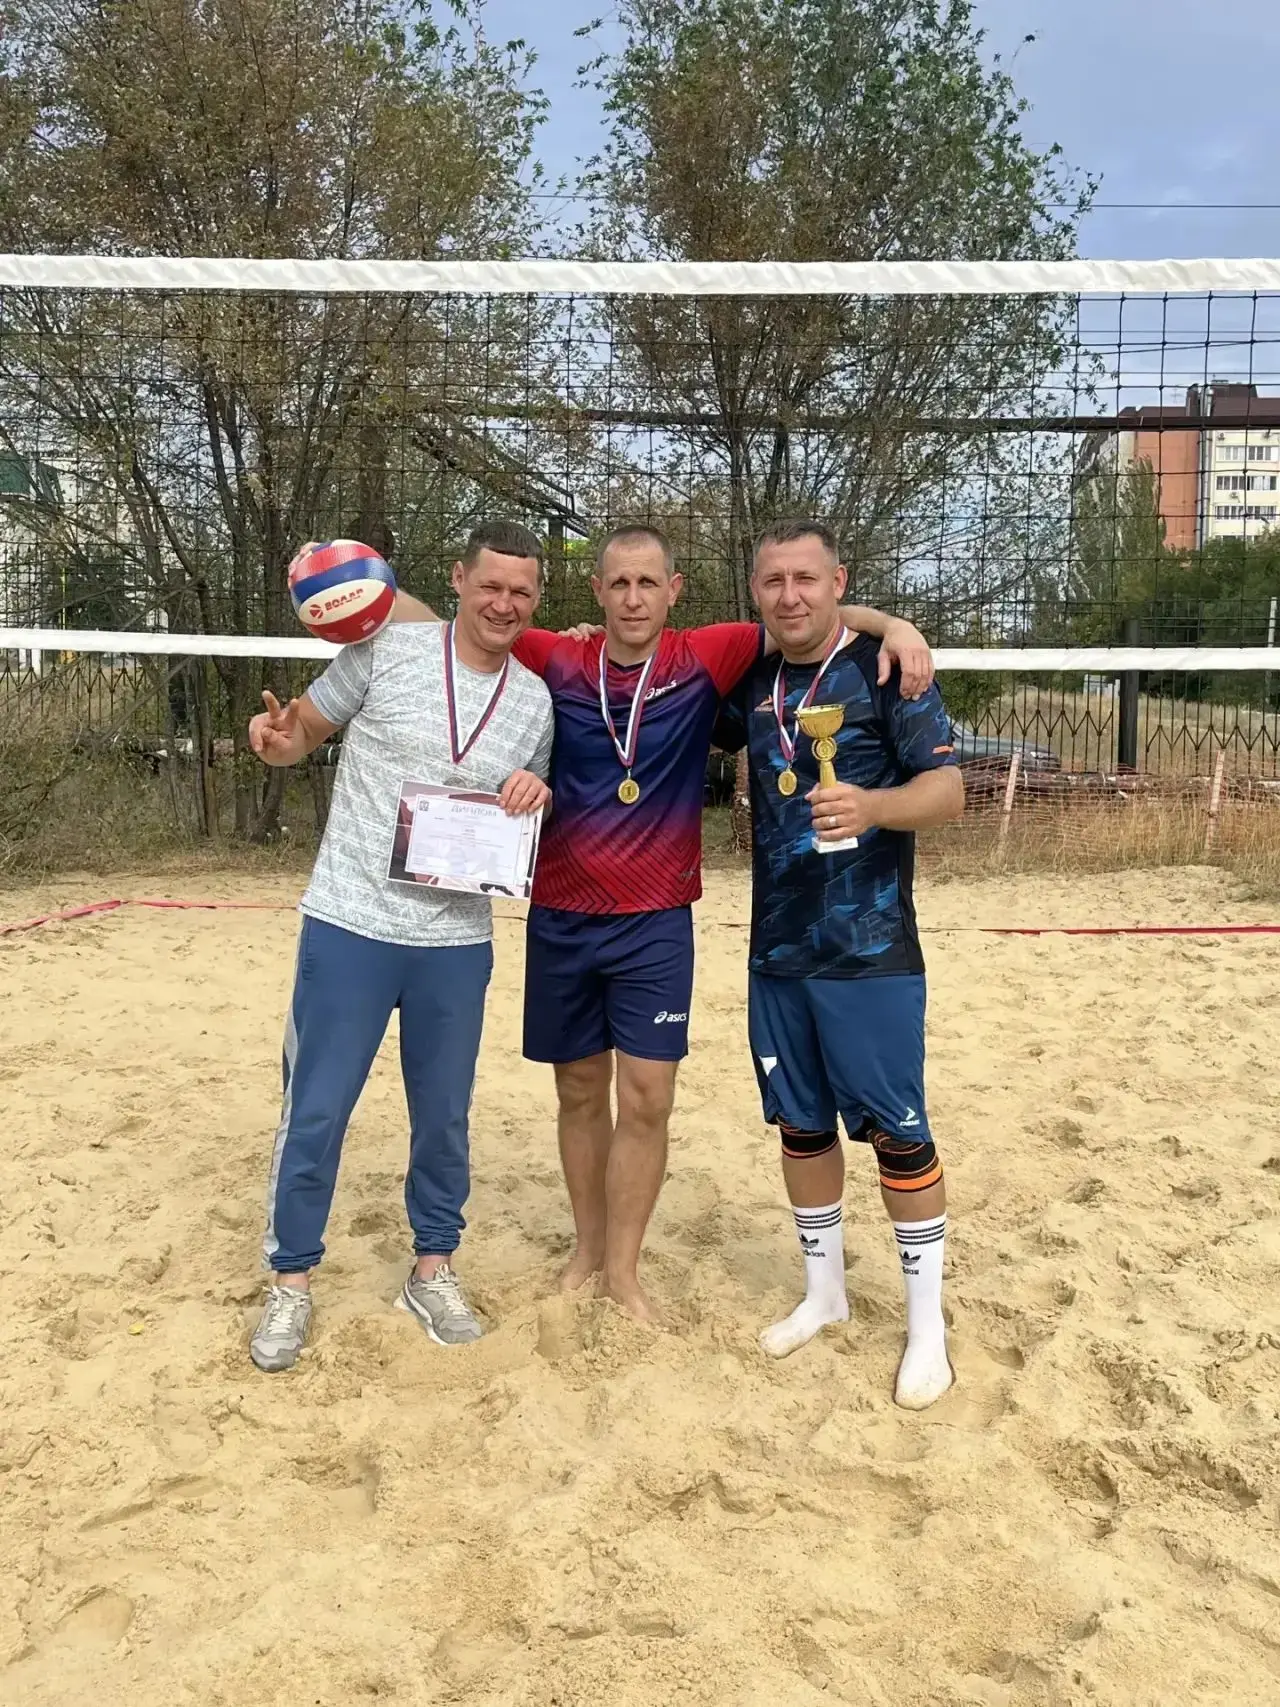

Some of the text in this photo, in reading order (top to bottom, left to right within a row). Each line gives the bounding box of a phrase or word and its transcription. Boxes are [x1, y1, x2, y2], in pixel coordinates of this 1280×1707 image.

[654, 679, 677, 697] ass
[451, 804, 497, 817] ДИПЛОМ
[666, 1012, 688, 1023] asics
